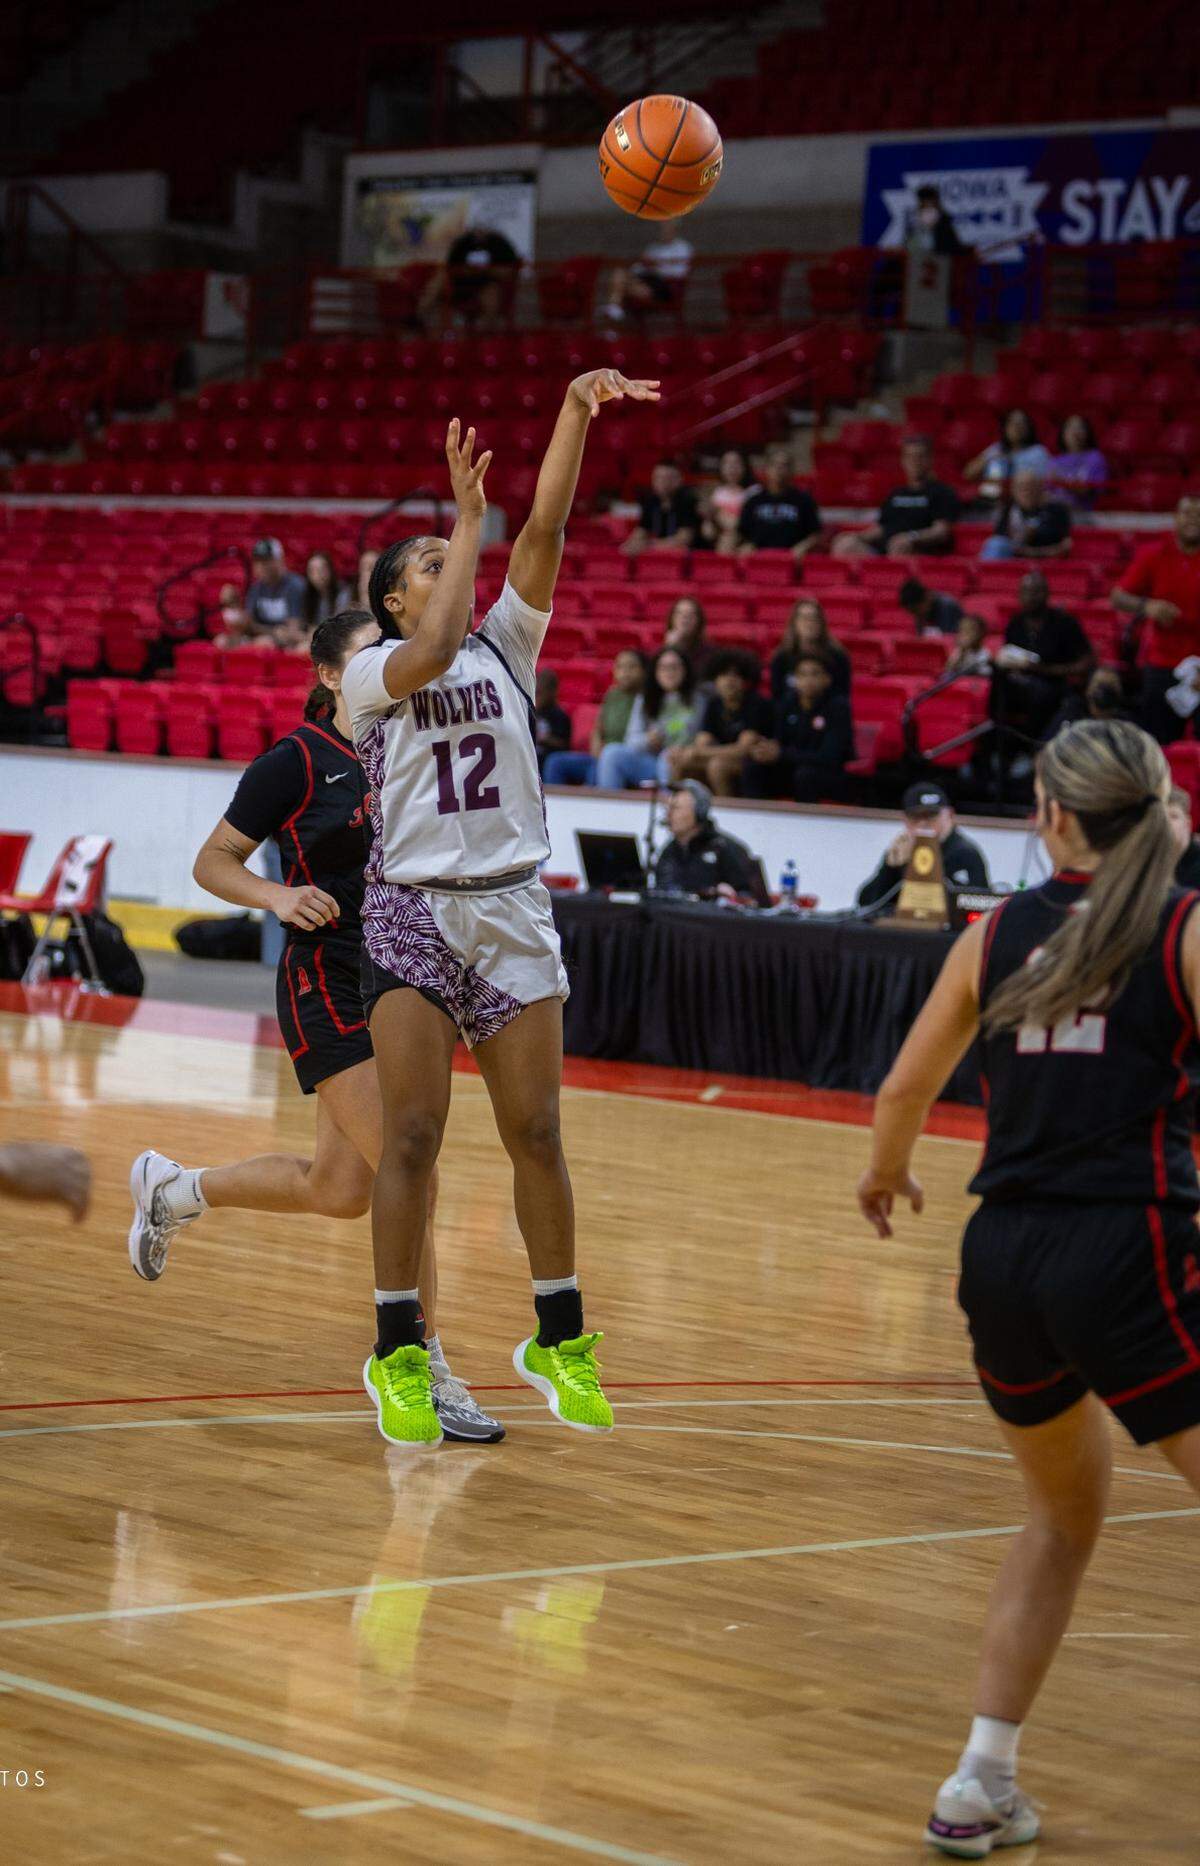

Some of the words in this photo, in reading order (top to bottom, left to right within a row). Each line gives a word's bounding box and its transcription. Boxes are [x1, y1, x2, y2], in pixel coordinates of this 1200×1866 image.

[1058, 174, 1192, 245] STAY
[409, 678, 504, 732] WOLVES
[431, 732, 501, 816] 12
